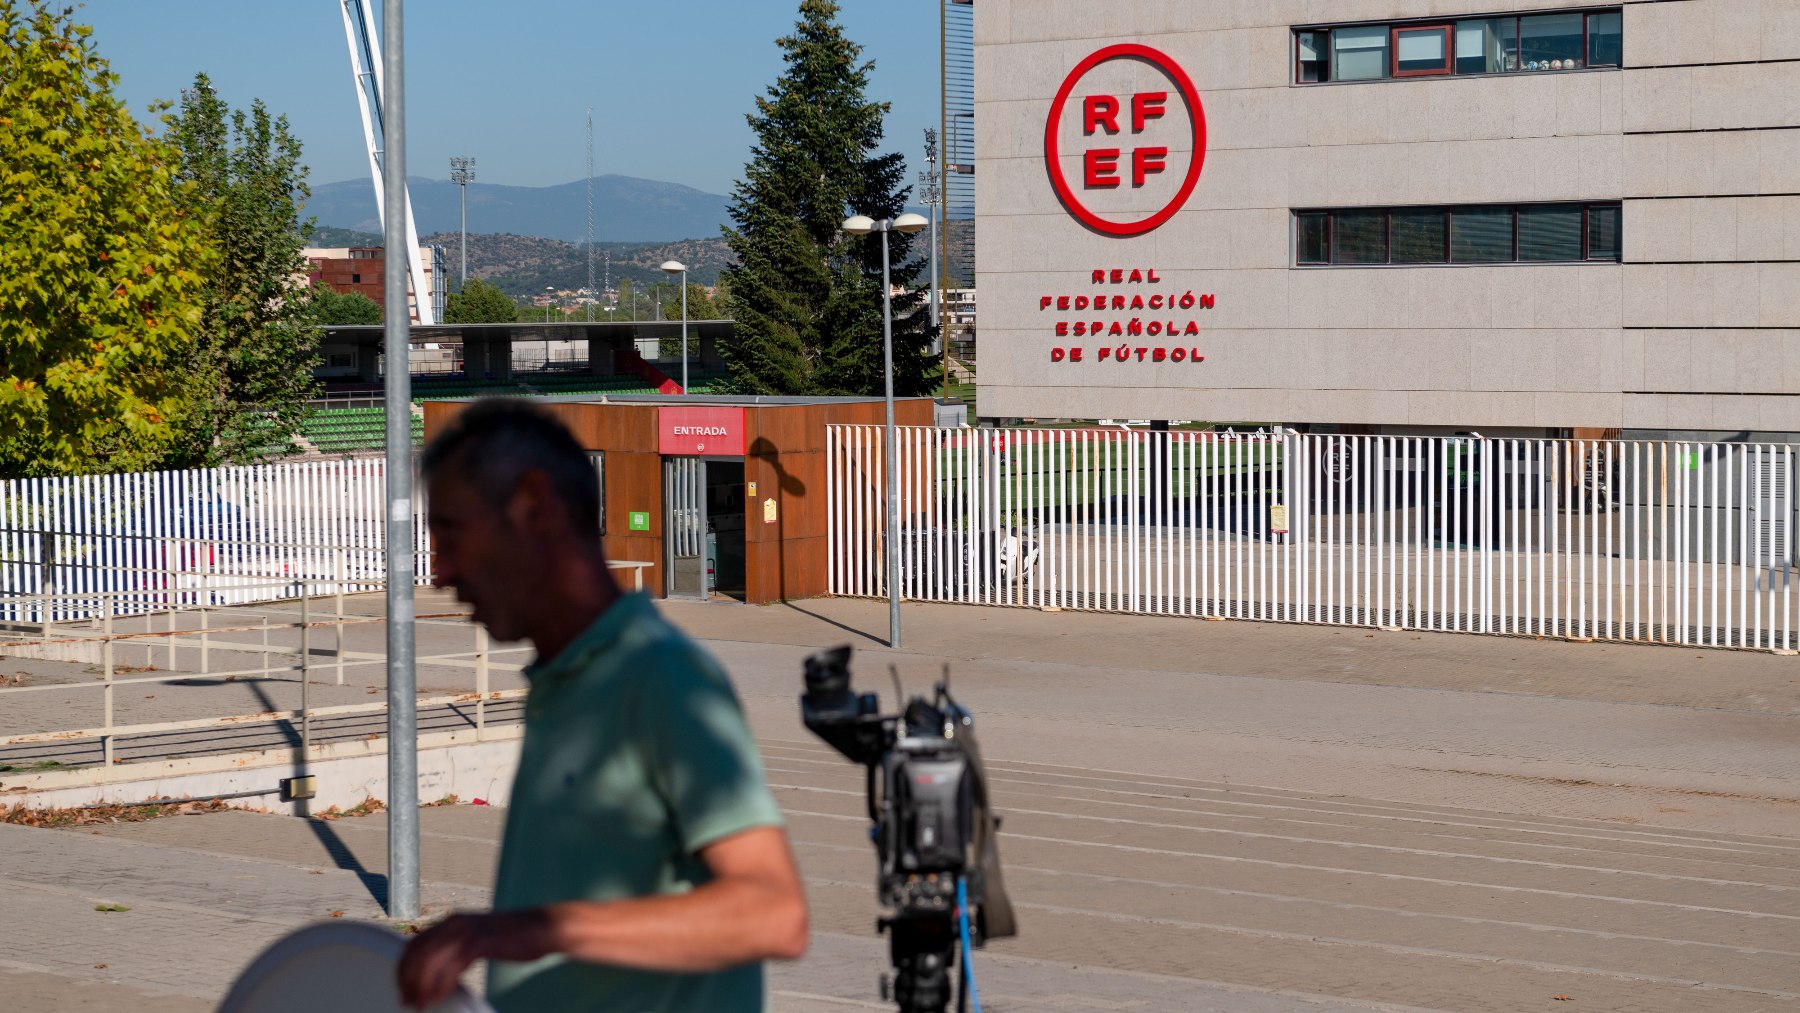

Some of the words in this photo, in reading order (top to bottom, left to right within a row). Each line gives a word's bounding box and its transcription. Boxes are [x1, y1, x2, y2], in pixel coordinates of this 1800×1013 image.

[1084, 92, 1168, 134] RF
[1084, 146, 1168, 187] EF
[1092, 268, 1161, 284] REAL
[1040, 290, 1215, 311] FEDERACIÓN
[1056, 317, 1199, 337] ESPAÑOLA
[1051, 347, 1083, 363] DE
[1098, 344, 1205, 363] FÚTBOL
[673, 426, 728, 436] ENTRADA
